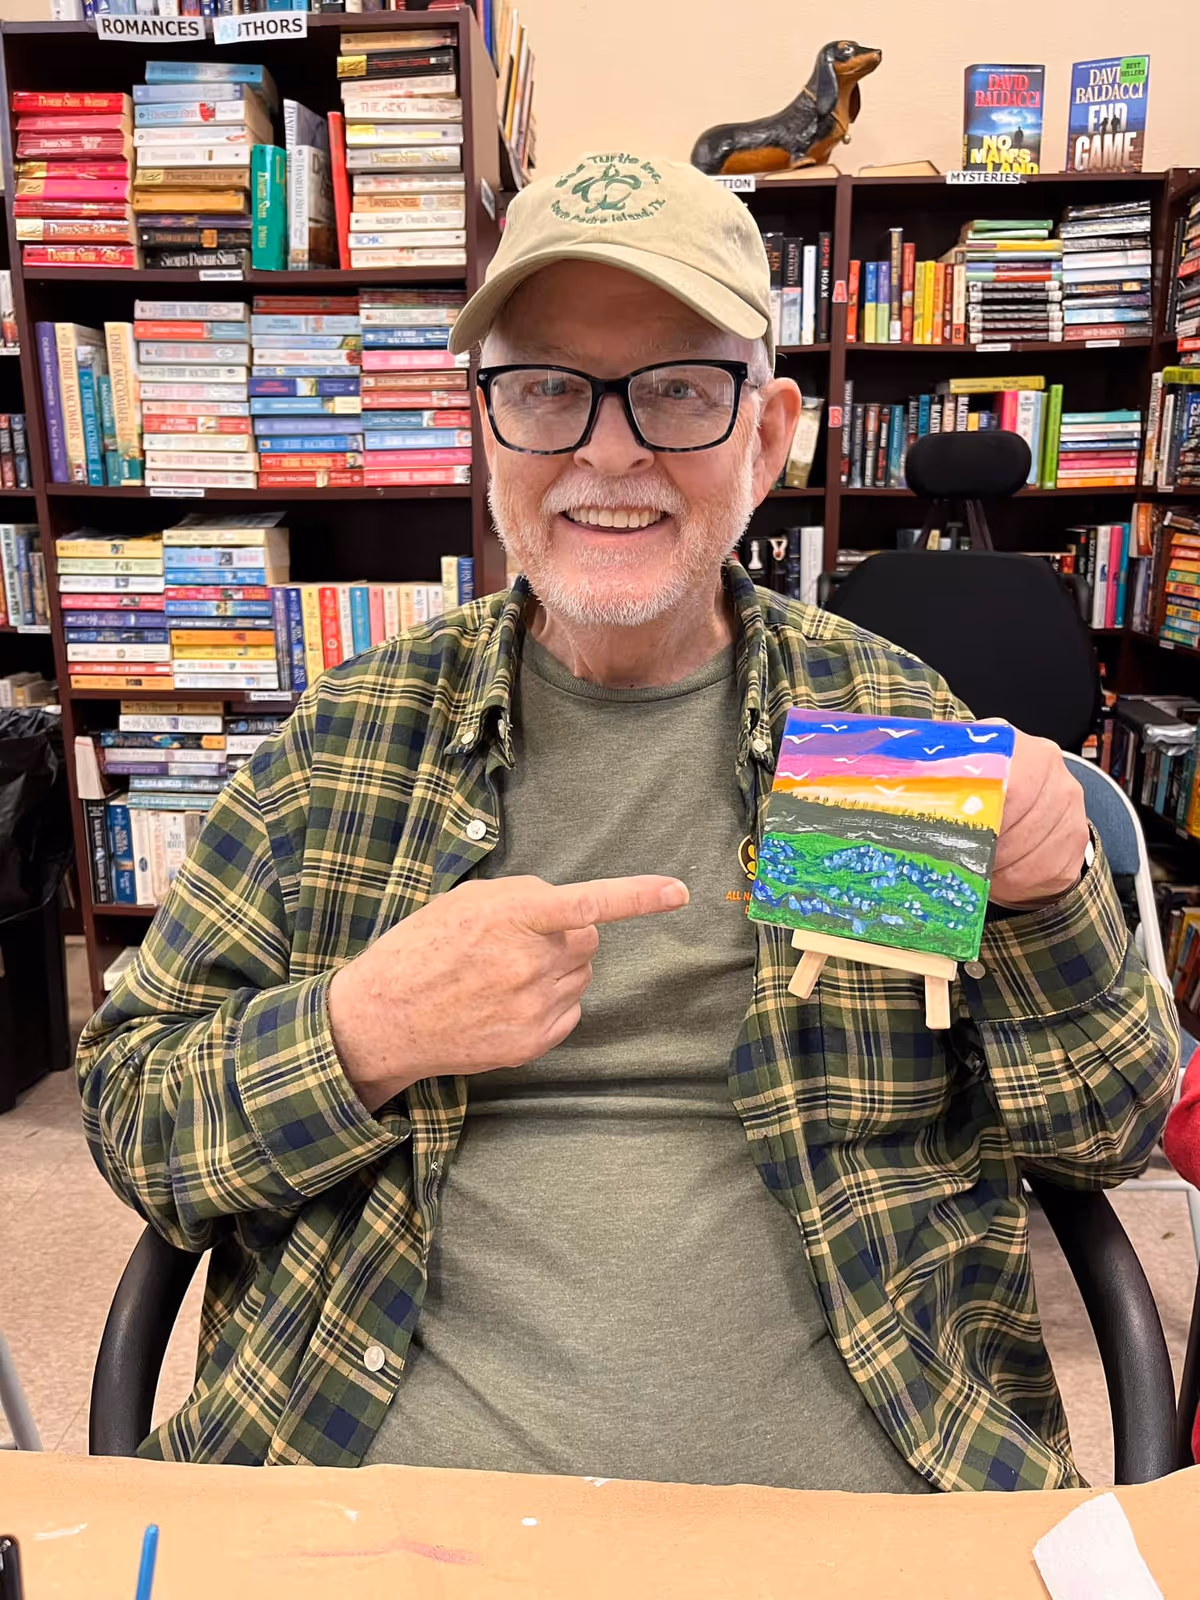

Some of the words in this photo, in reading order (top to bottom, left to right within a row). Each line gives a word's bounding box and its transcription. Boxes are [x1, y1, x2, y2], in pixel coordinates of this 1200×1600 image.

[102, 18, 199, 36] ROMANCES
[988, 74, 1030, 91] DAVID
[1089, 66, 1121, 86] DAVI
[975, 91, 1041, 107] BALDACCI
[1075, 82, 1144, 105] BALDACCI
[1088, 102, 1128, 133] END
[983, 134, 1013, 151] NO
[1074, 131, 1137, 171] GAME
[714, 178, 751, 189] TION
[950, 172, 1019, 182] MYSTERIES
[820, 270, 830, 298] HOAX
[109, 333, 121, 364] DEBBIE
[61, 347, 74, 380] DEBBIE
[101, 383, 112, 427] MACOMBER
[113, 368, 129, 423] MACOMBER
[64, 384, 81, 440] MACOMBER
[930, 404, 941, 433] BLACKST
[944, 402, 955, 432] BLACKSTO
[957, 397, 969, 431] BLACKSTO
[725, 890, 741, 901] ALL
[743, 891, 751, 901] N
